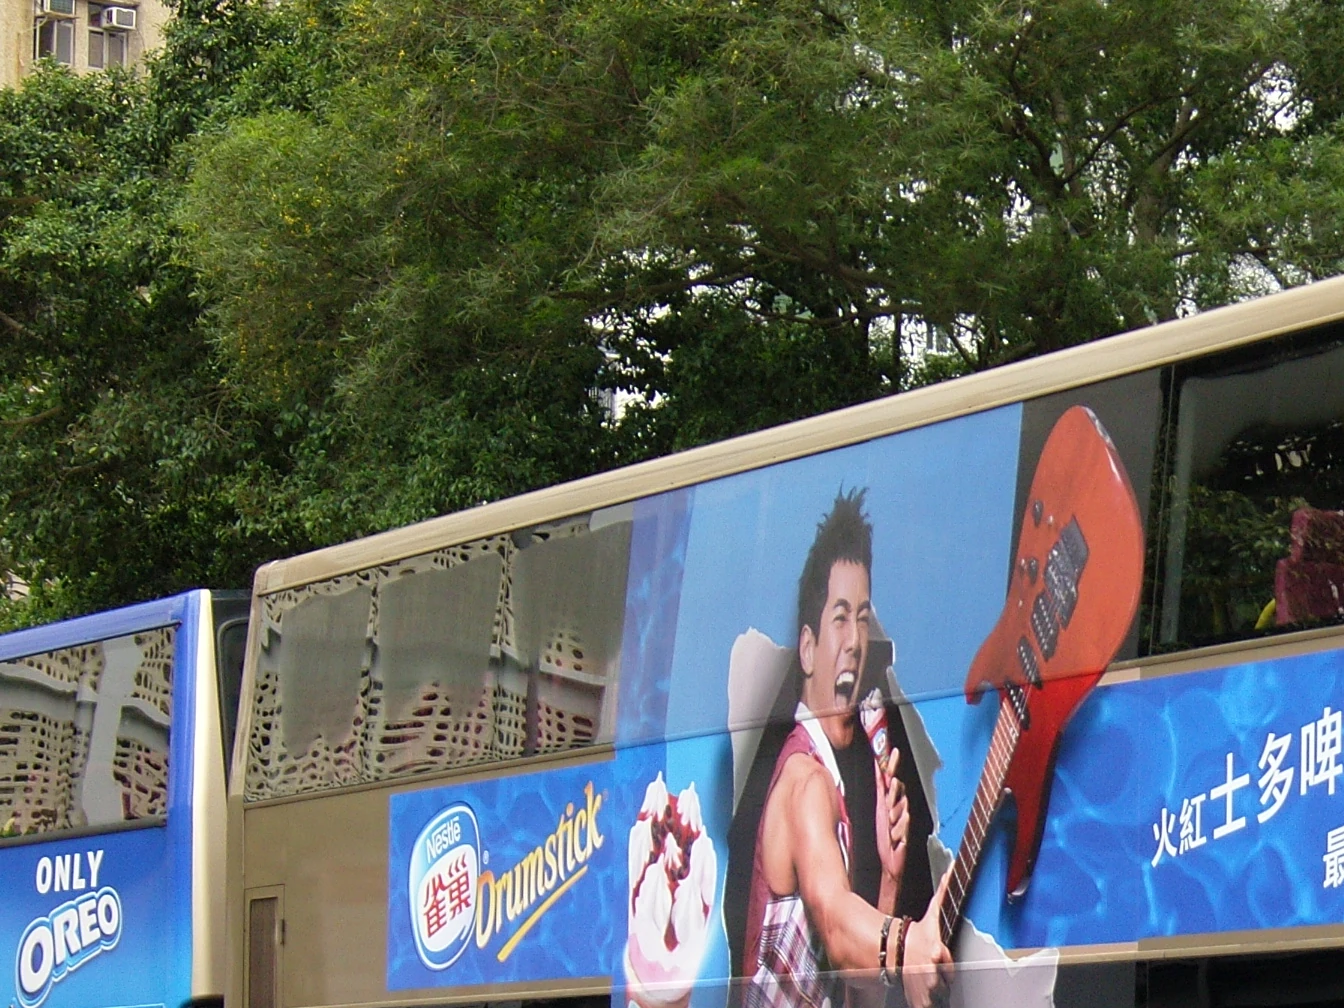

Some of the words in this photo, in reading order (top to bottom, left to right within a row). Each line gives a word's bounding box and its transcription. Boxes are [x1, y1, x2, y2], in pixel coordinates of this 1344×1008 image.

[36, 850, 104, 894] ONLY
[423, 852, 472, 938] 雀巢
[475, 780, 604, 949] Drumstick
[19, 893, 119, 994] OREO
